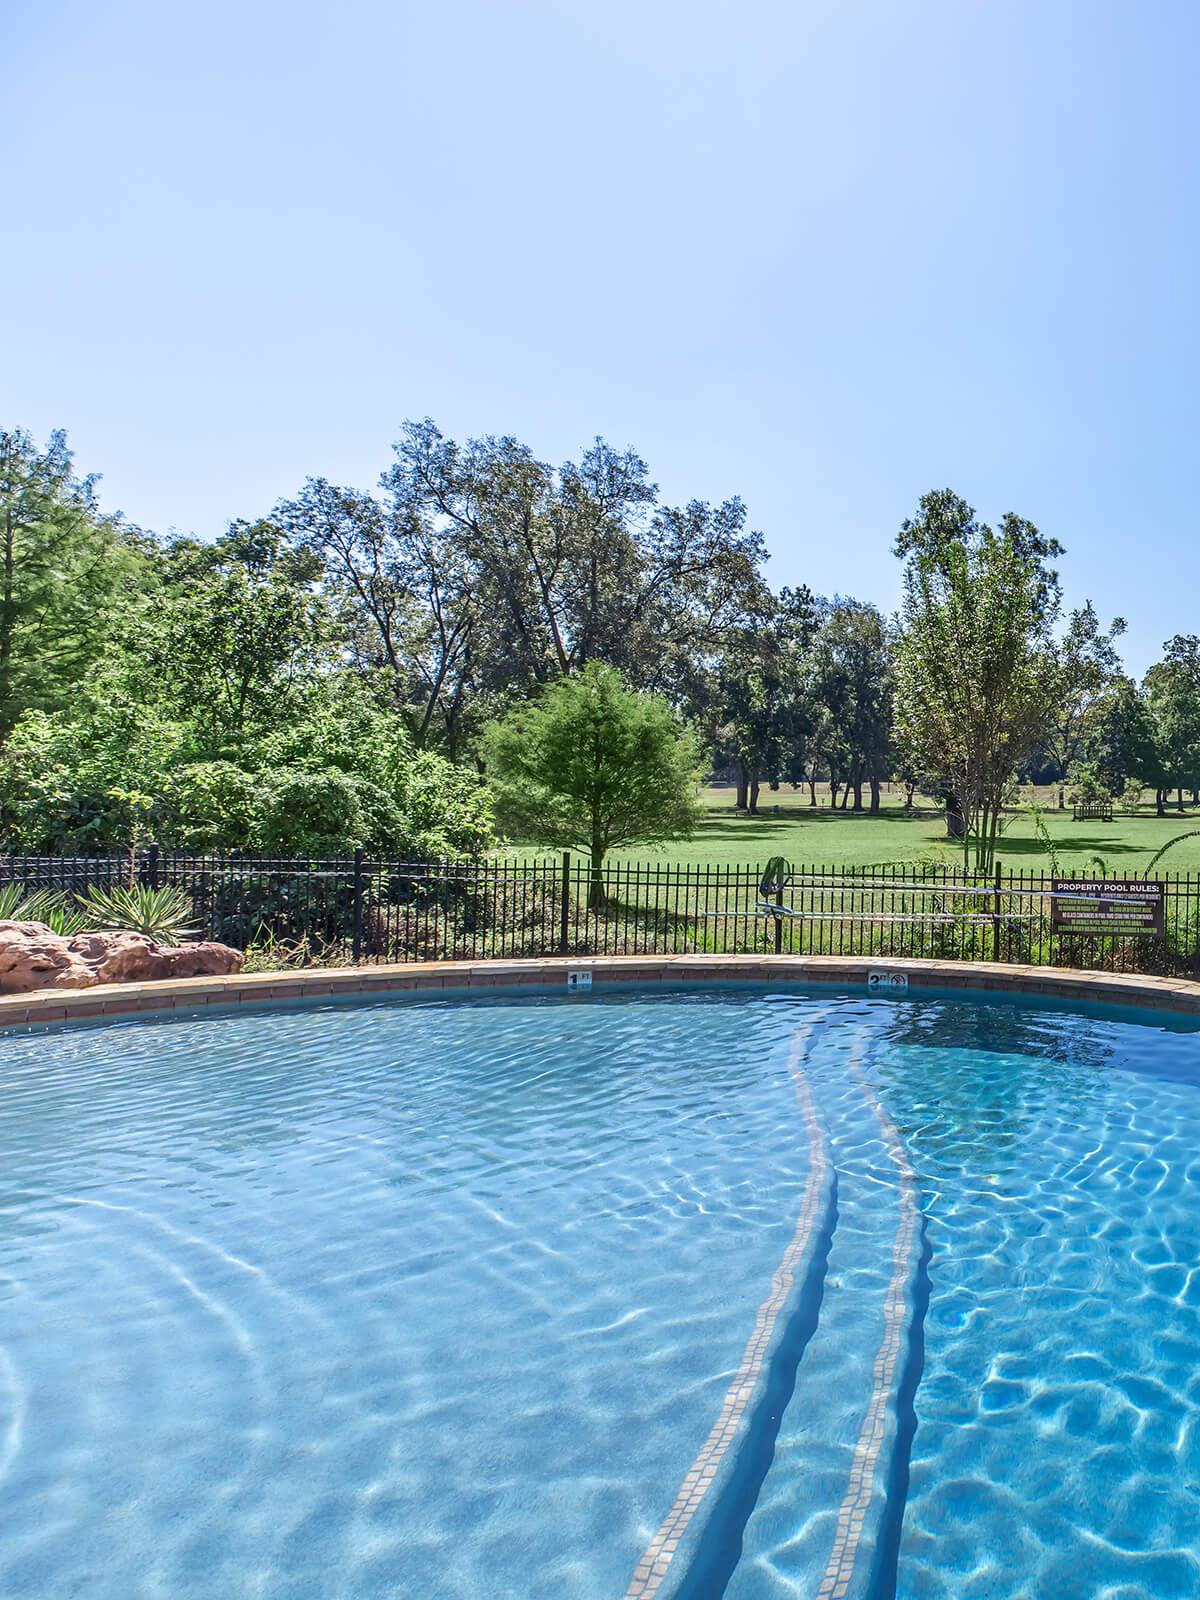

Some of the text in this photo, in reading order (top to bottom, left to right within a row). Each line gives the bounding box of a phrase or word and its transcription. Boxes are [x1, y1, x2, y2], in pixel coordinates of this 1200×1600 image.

[1057, 883, 1102, 891] PROPERTY
[1104, 884, 1128, 892] POOL
[870, 975, 880, 985] 2
